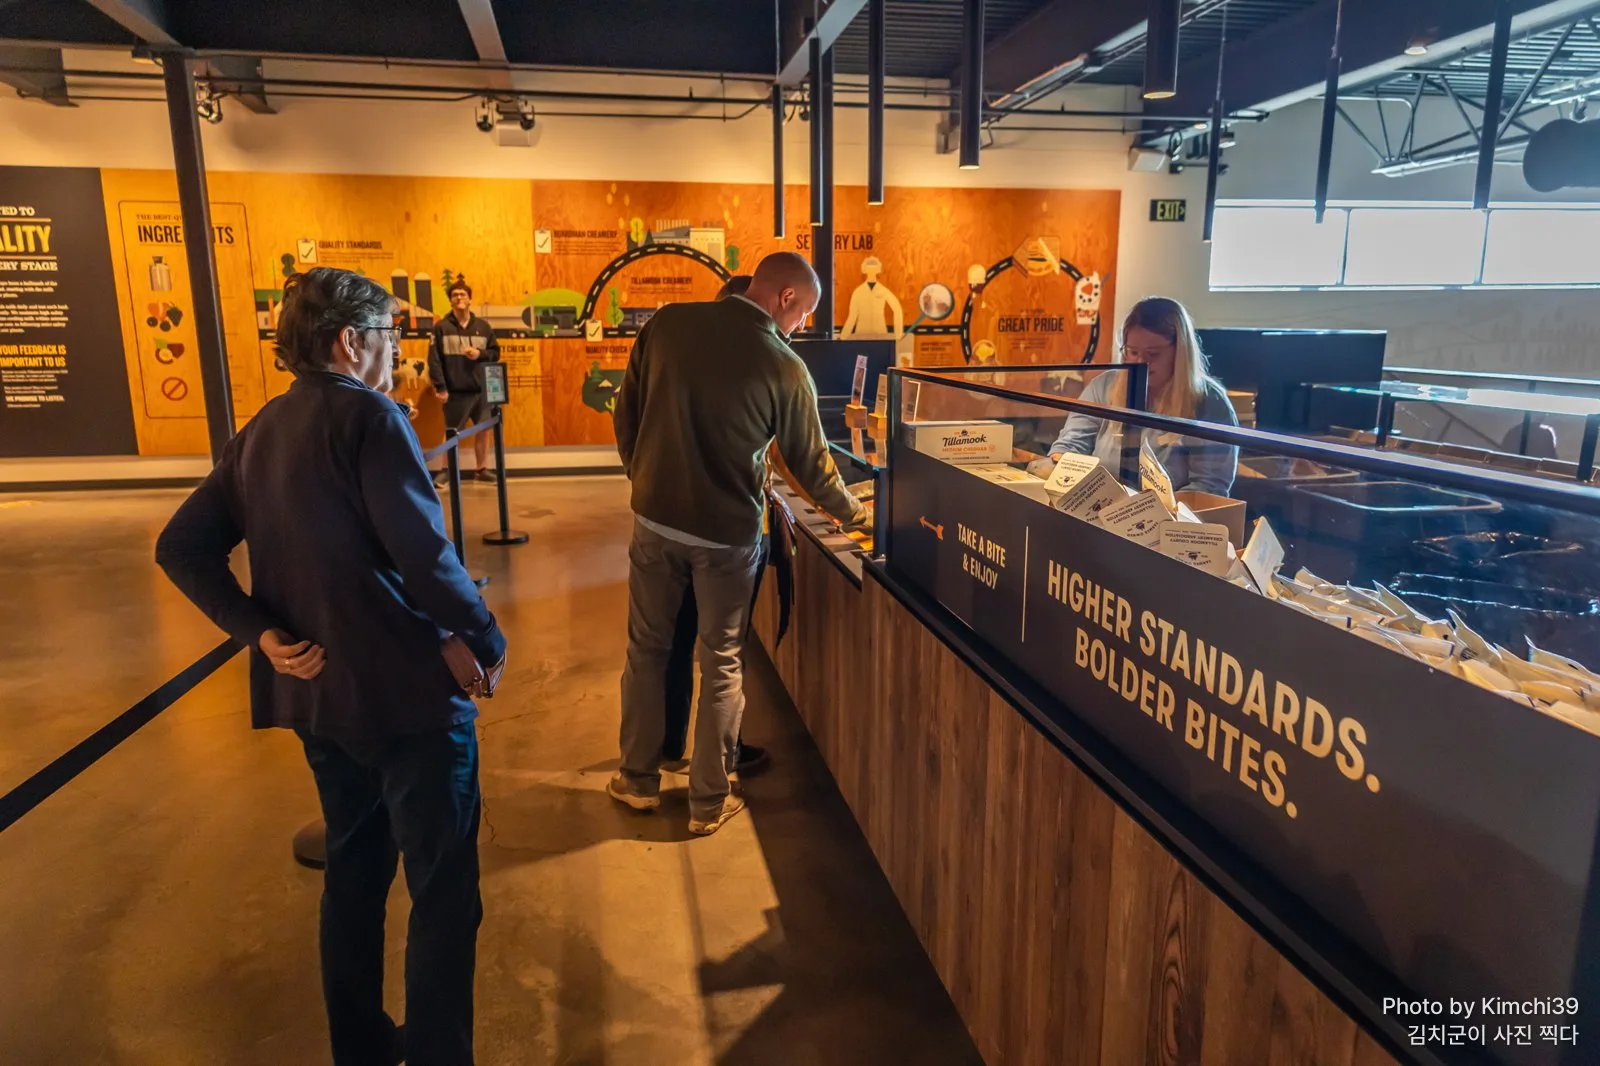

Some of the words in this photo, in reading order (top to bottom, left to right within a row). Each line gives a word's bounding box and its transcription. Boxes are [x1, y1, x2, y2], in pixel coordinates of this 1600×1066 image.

[19, 206, 36, 216] TO
[1156, 201, 1180, 220] EXIT
[587, 230, 617, 238] CREAMERY
[318, 240, 344, 248] QUALITY
[346, 240, 383, 249] STANDARDS
[796, 233, 850, 250] SERY
[852, 234, 874, 250] LAB
[20, 261, 58, 271] STAGE
[662, 276, 693, 284] CREAMERY
[998, 316, 1031, 332] GREAT
[1033, 316, 1064, 332] PRIDE
[0, 344, 19, 355] YOUR
[19, 344, 58, 355] FEEDBACK
[58, 344, 67, 355] IS
[0, 356, 43, 367] IMPORTANT
[44, 356, 54, 367] TO
[55, 356, 66, 367] US
[942, 434, 988, 447] Tillamook
[957, 522, 977, 550] TAKE
[978, 535, 985, 555] A
[986, 539, 1006, 568] BITE
[962, 553, 969, 572] &
[970, 557, 998, 590] ENJOY
[1048, 559, 1132, 643] HIGHER
[1139, 610, 1381, 793] STANDARDS.
[1075, 627, 1176, 732] BOLDER
[1185, 697, 1298, 819] BITES.
